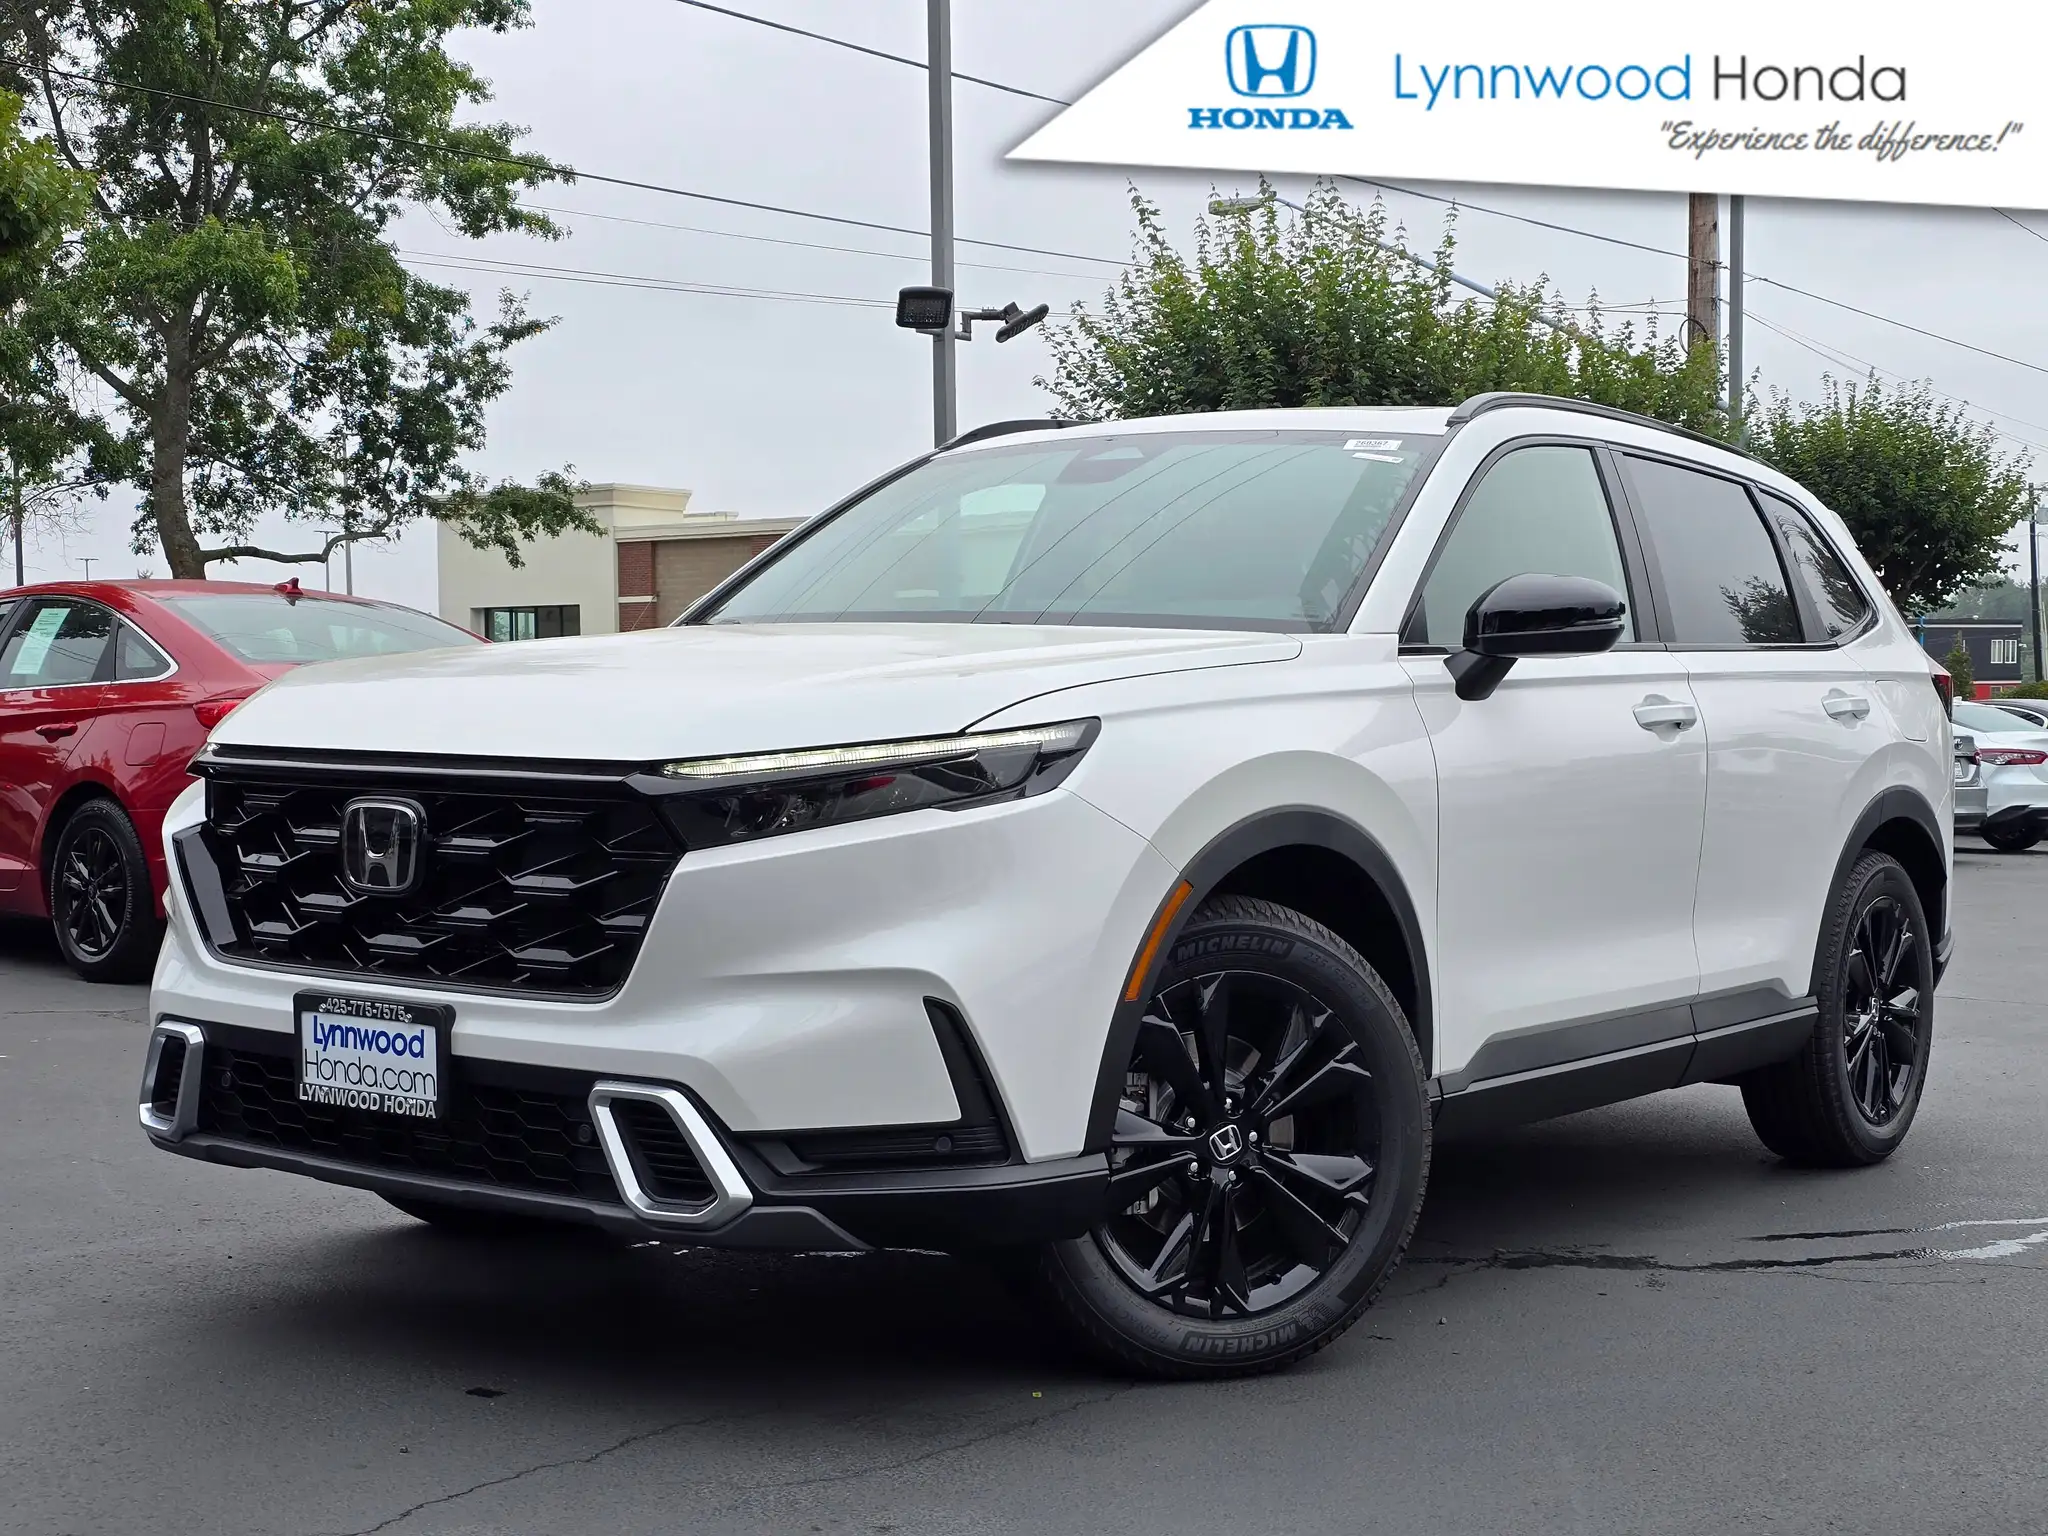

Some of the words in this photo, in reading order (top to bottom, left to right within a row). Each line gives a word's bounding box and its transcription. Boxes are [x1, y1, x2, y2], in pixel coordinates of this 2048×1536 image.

[1176, 935, 1290, 961] MICHELIN
[326, 998, 406, 1021] 425-775-7575
[313, 1015, 425, 1058] Lynnwood
[304, 1048, 437, 1097] Honda.com
[299, 1083, 380, 1110] LYNNWOOD
[384, 1095, 437, 1118] HONDA
[1185, 1323, 1297, 1351] MICHELIN
